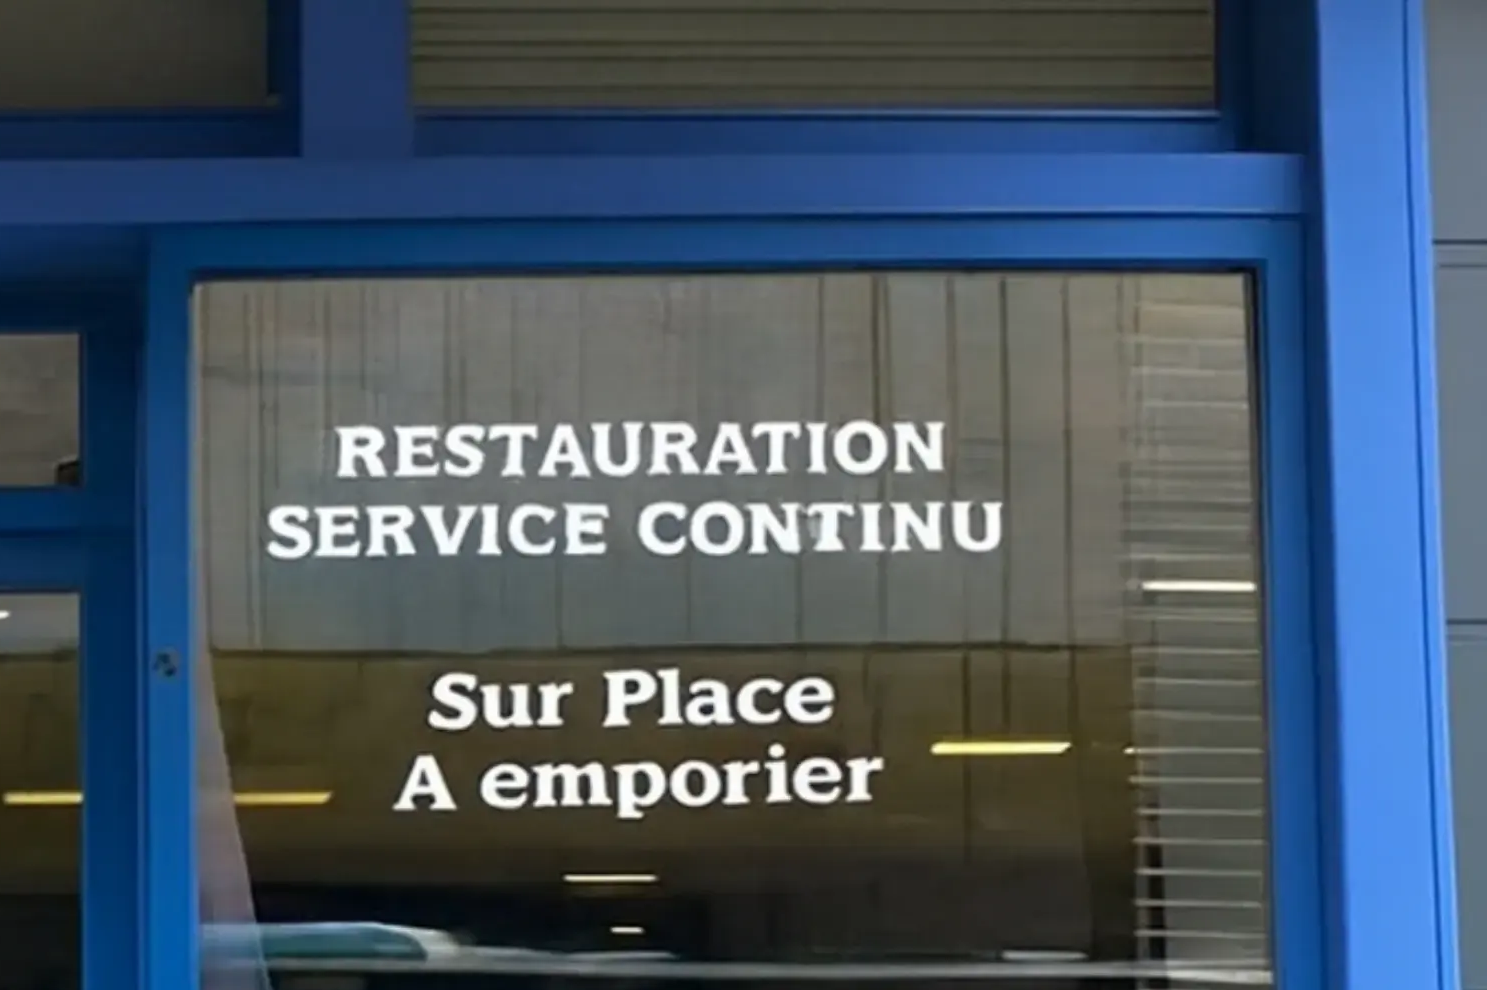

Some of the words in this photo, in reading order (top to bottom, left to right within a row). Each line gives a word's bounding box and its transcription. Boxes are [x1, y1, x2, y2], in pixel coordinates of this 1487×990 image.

[335, 420, 945, 478] RESTAURATION
[267, 503, 610, 560] SERVICE
[637, 501, 1003, 556] CONTINU
[428, 672, 574, 731] Sur
[603, 668, 835, 729] Place
[393, 755, 457, 811] A
